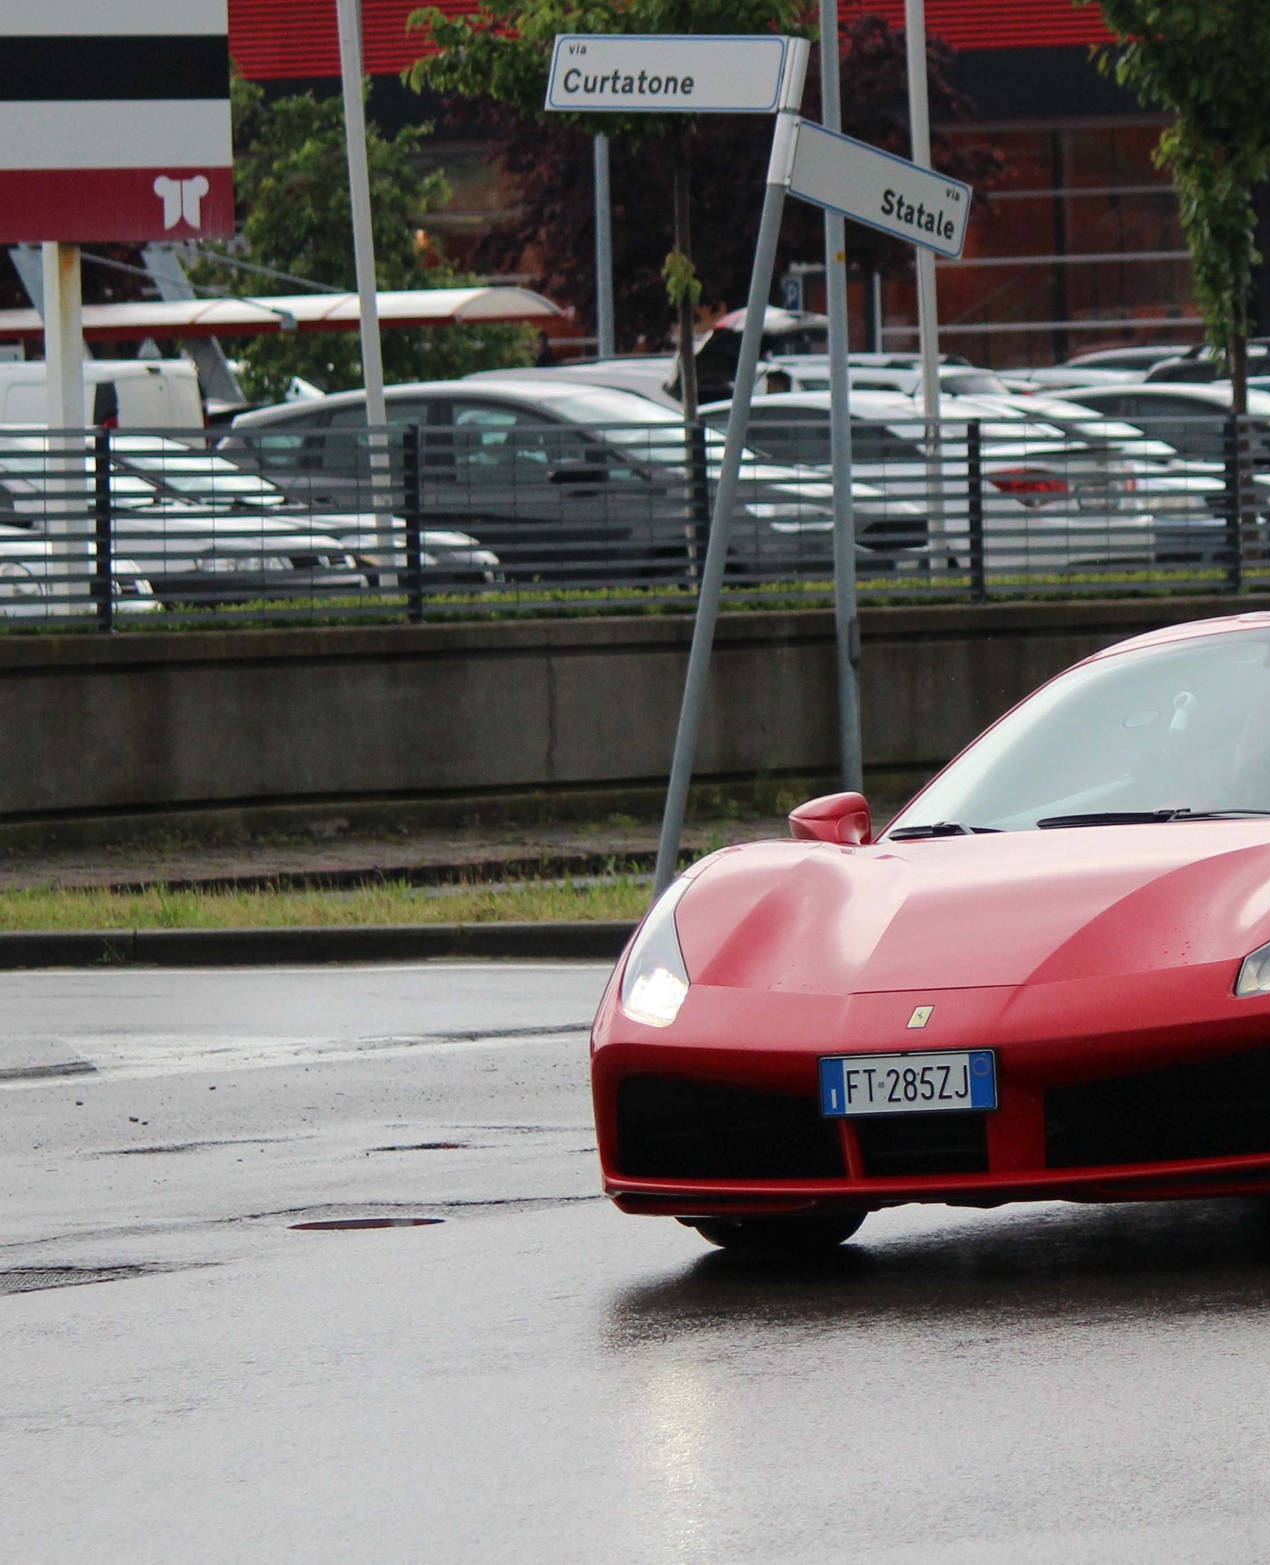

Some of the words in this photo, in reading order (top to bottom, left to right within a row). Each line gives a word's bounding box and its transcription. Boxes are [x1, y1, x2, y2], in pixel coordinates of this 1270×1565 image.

[569, 43, 587, 55] via
[563, 68, 695, 94] Curtatone
[946, 187, 960, 202] via
[881, 188, 954, 240] Statale
